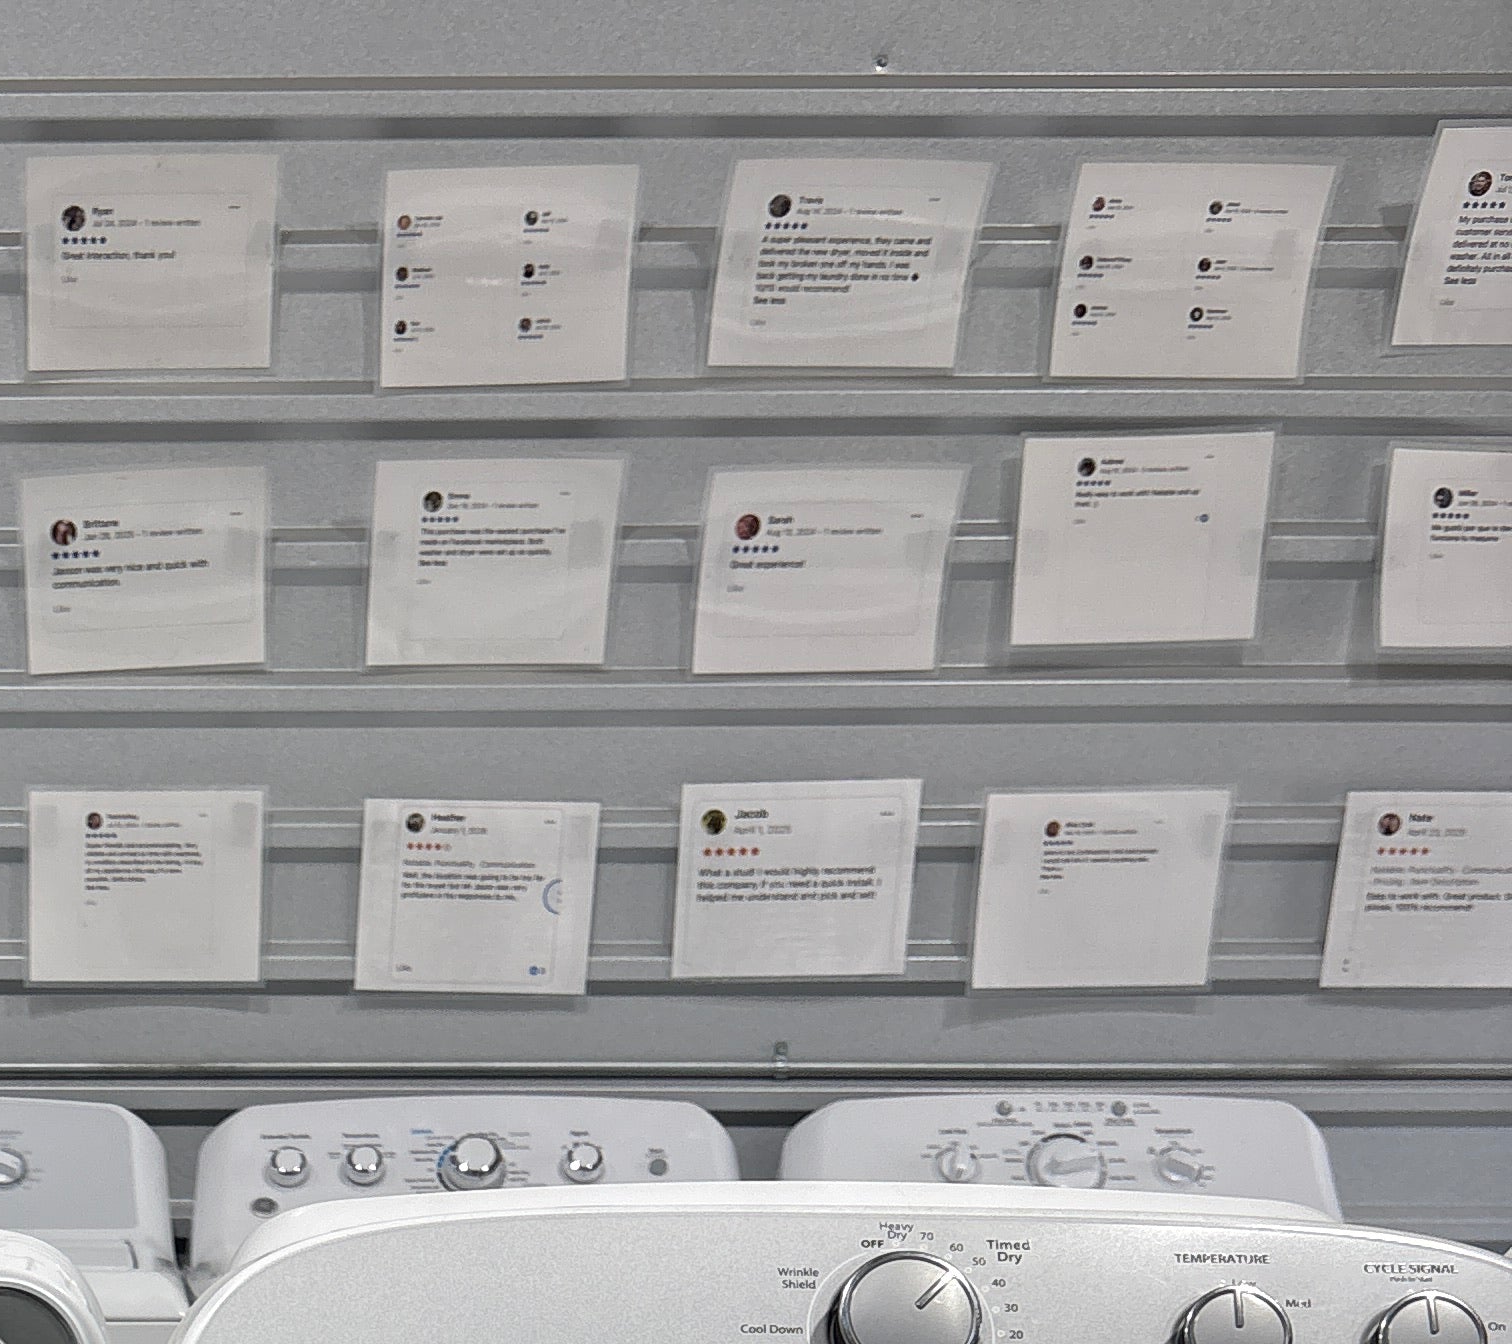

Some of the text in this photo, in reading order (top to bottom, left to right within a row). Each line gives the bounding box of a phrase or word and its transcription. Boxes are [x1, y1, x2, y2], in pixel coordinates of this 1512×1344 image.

[879, 1222, 913, 1232] Heavy
[887, 1230, 907, 1241] Dry
[919, 1232, 934, 1240] 70
[861, 1240, 884, 1248] OFF
[949, 1243, 963, 1252] 60
[987, 1239, 1030, 1251] Timed
[973, 1257, 986, 1266] 50
[997, 1252, 1022, 1264] Dry
[1175, 1254, 1270, 1264] TEMPERATURE
[778, 1268, 819, 1277] Wrinkle
[1364, 1264, 1458, 1274] CYCLE SIGNAL
[782, 1280, 816, 1289] Shield
[992, 1279, 1006, 1287] 40
[1004, 1304, 1018, 1312] 30
[741, 1324, 803, 1334] Cool Down
[1488, 1322, 1506, 1331] On
[1009, 1330, 1023, 1339] 20
